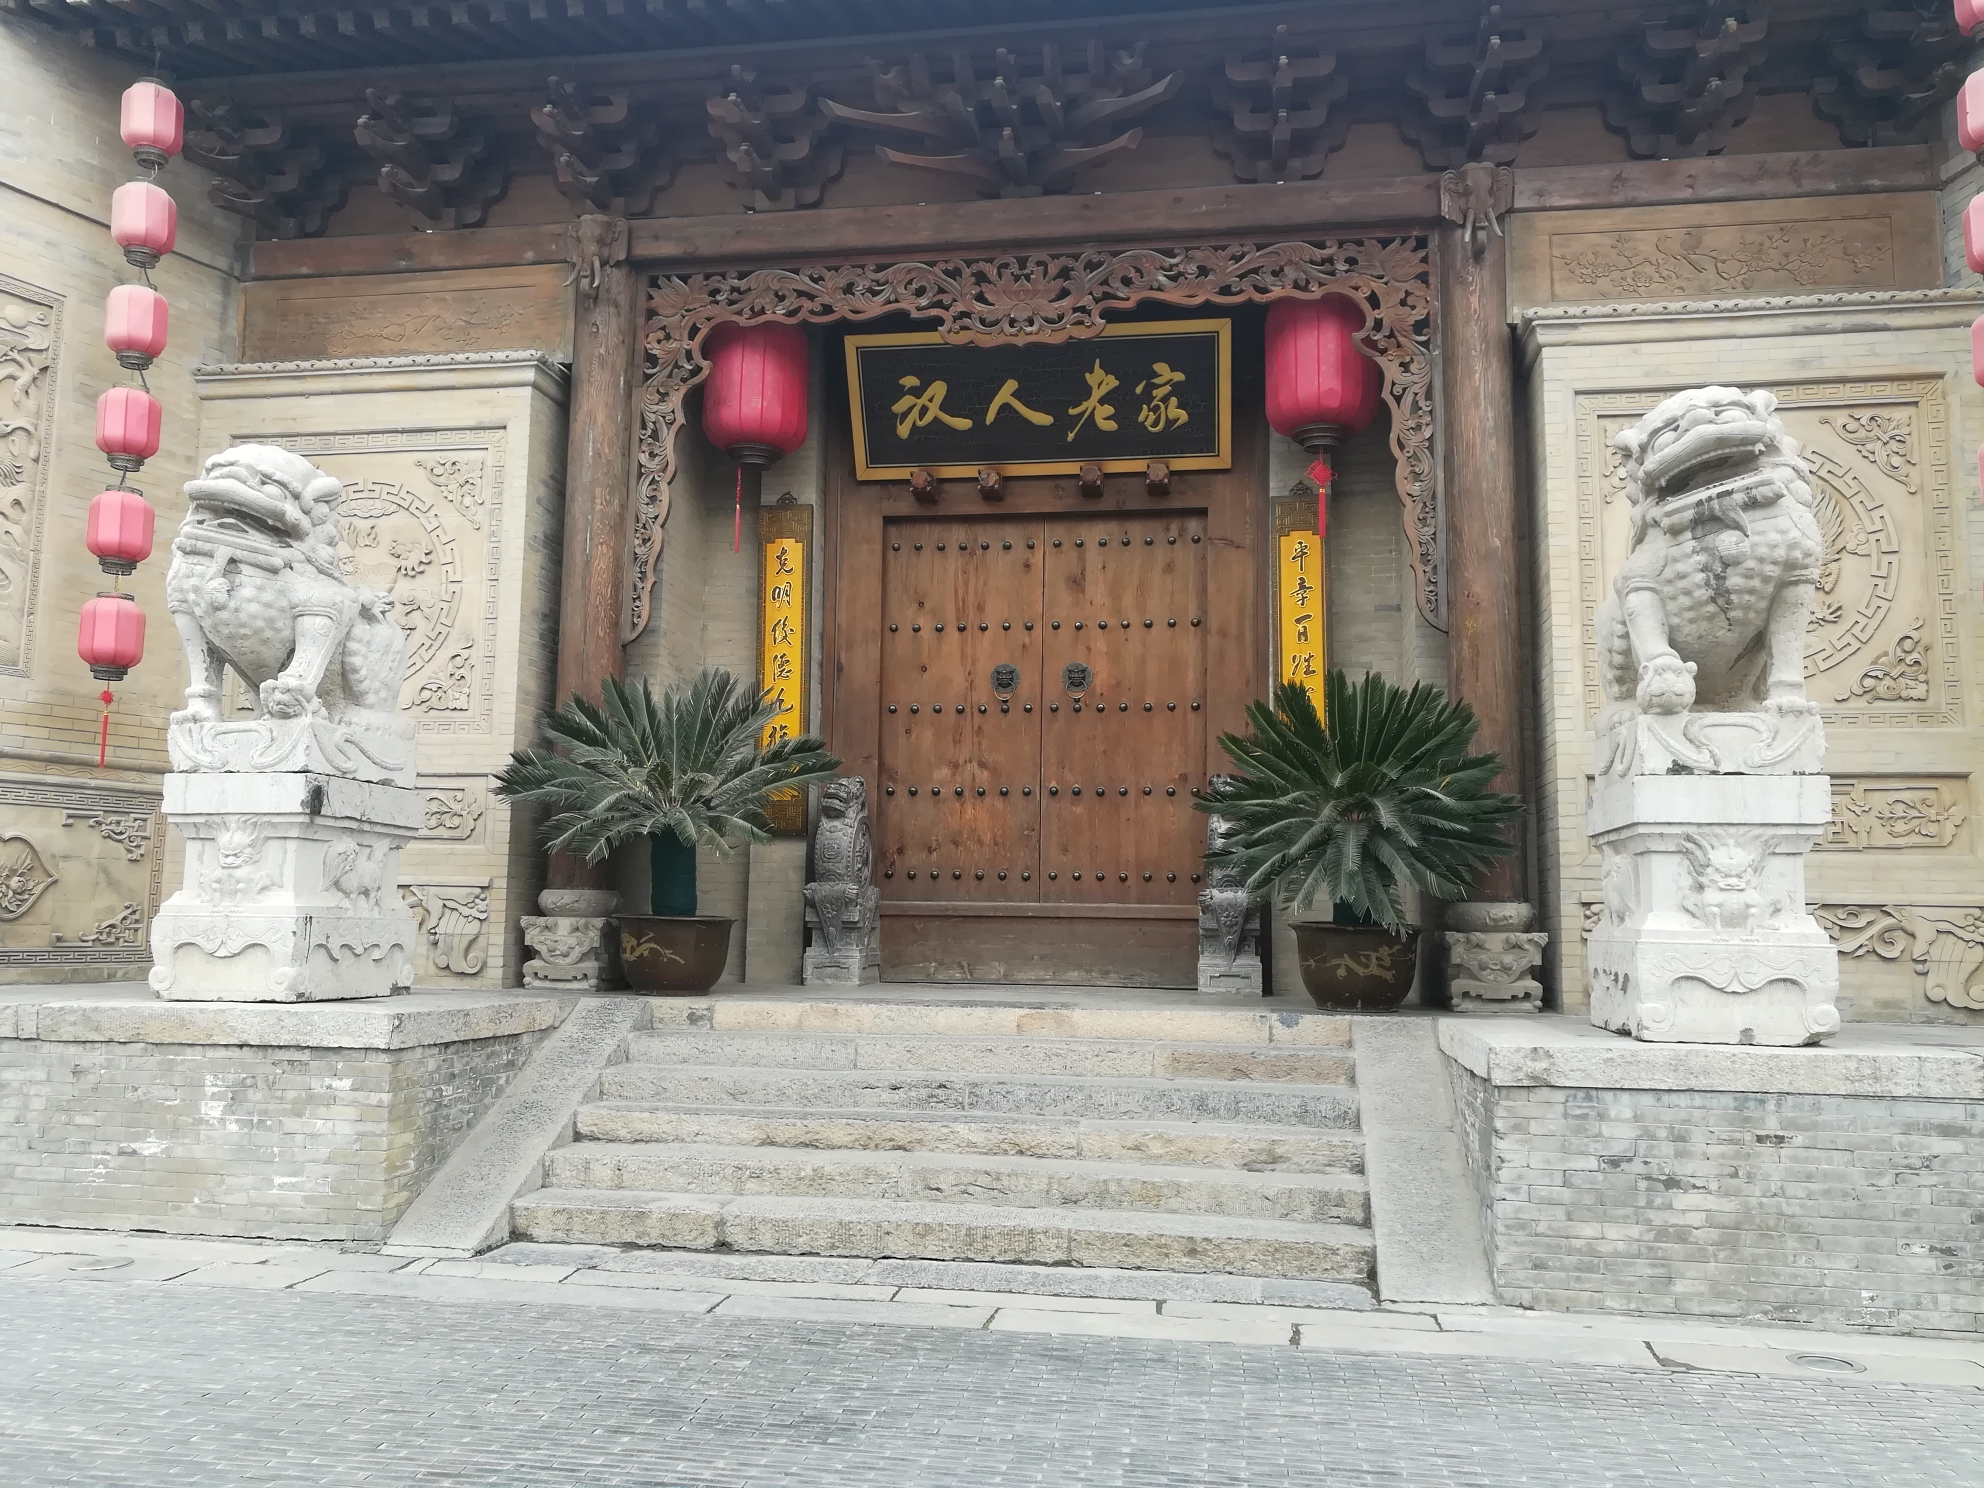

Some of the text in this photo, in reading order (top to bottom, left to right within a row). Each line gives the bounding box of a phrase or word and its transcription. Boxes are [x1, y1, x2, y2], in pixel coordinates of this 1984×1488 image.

[891, 358, 1189, 442] 汉人老家
[1289, 540, 1318, 703] 平章百姓
